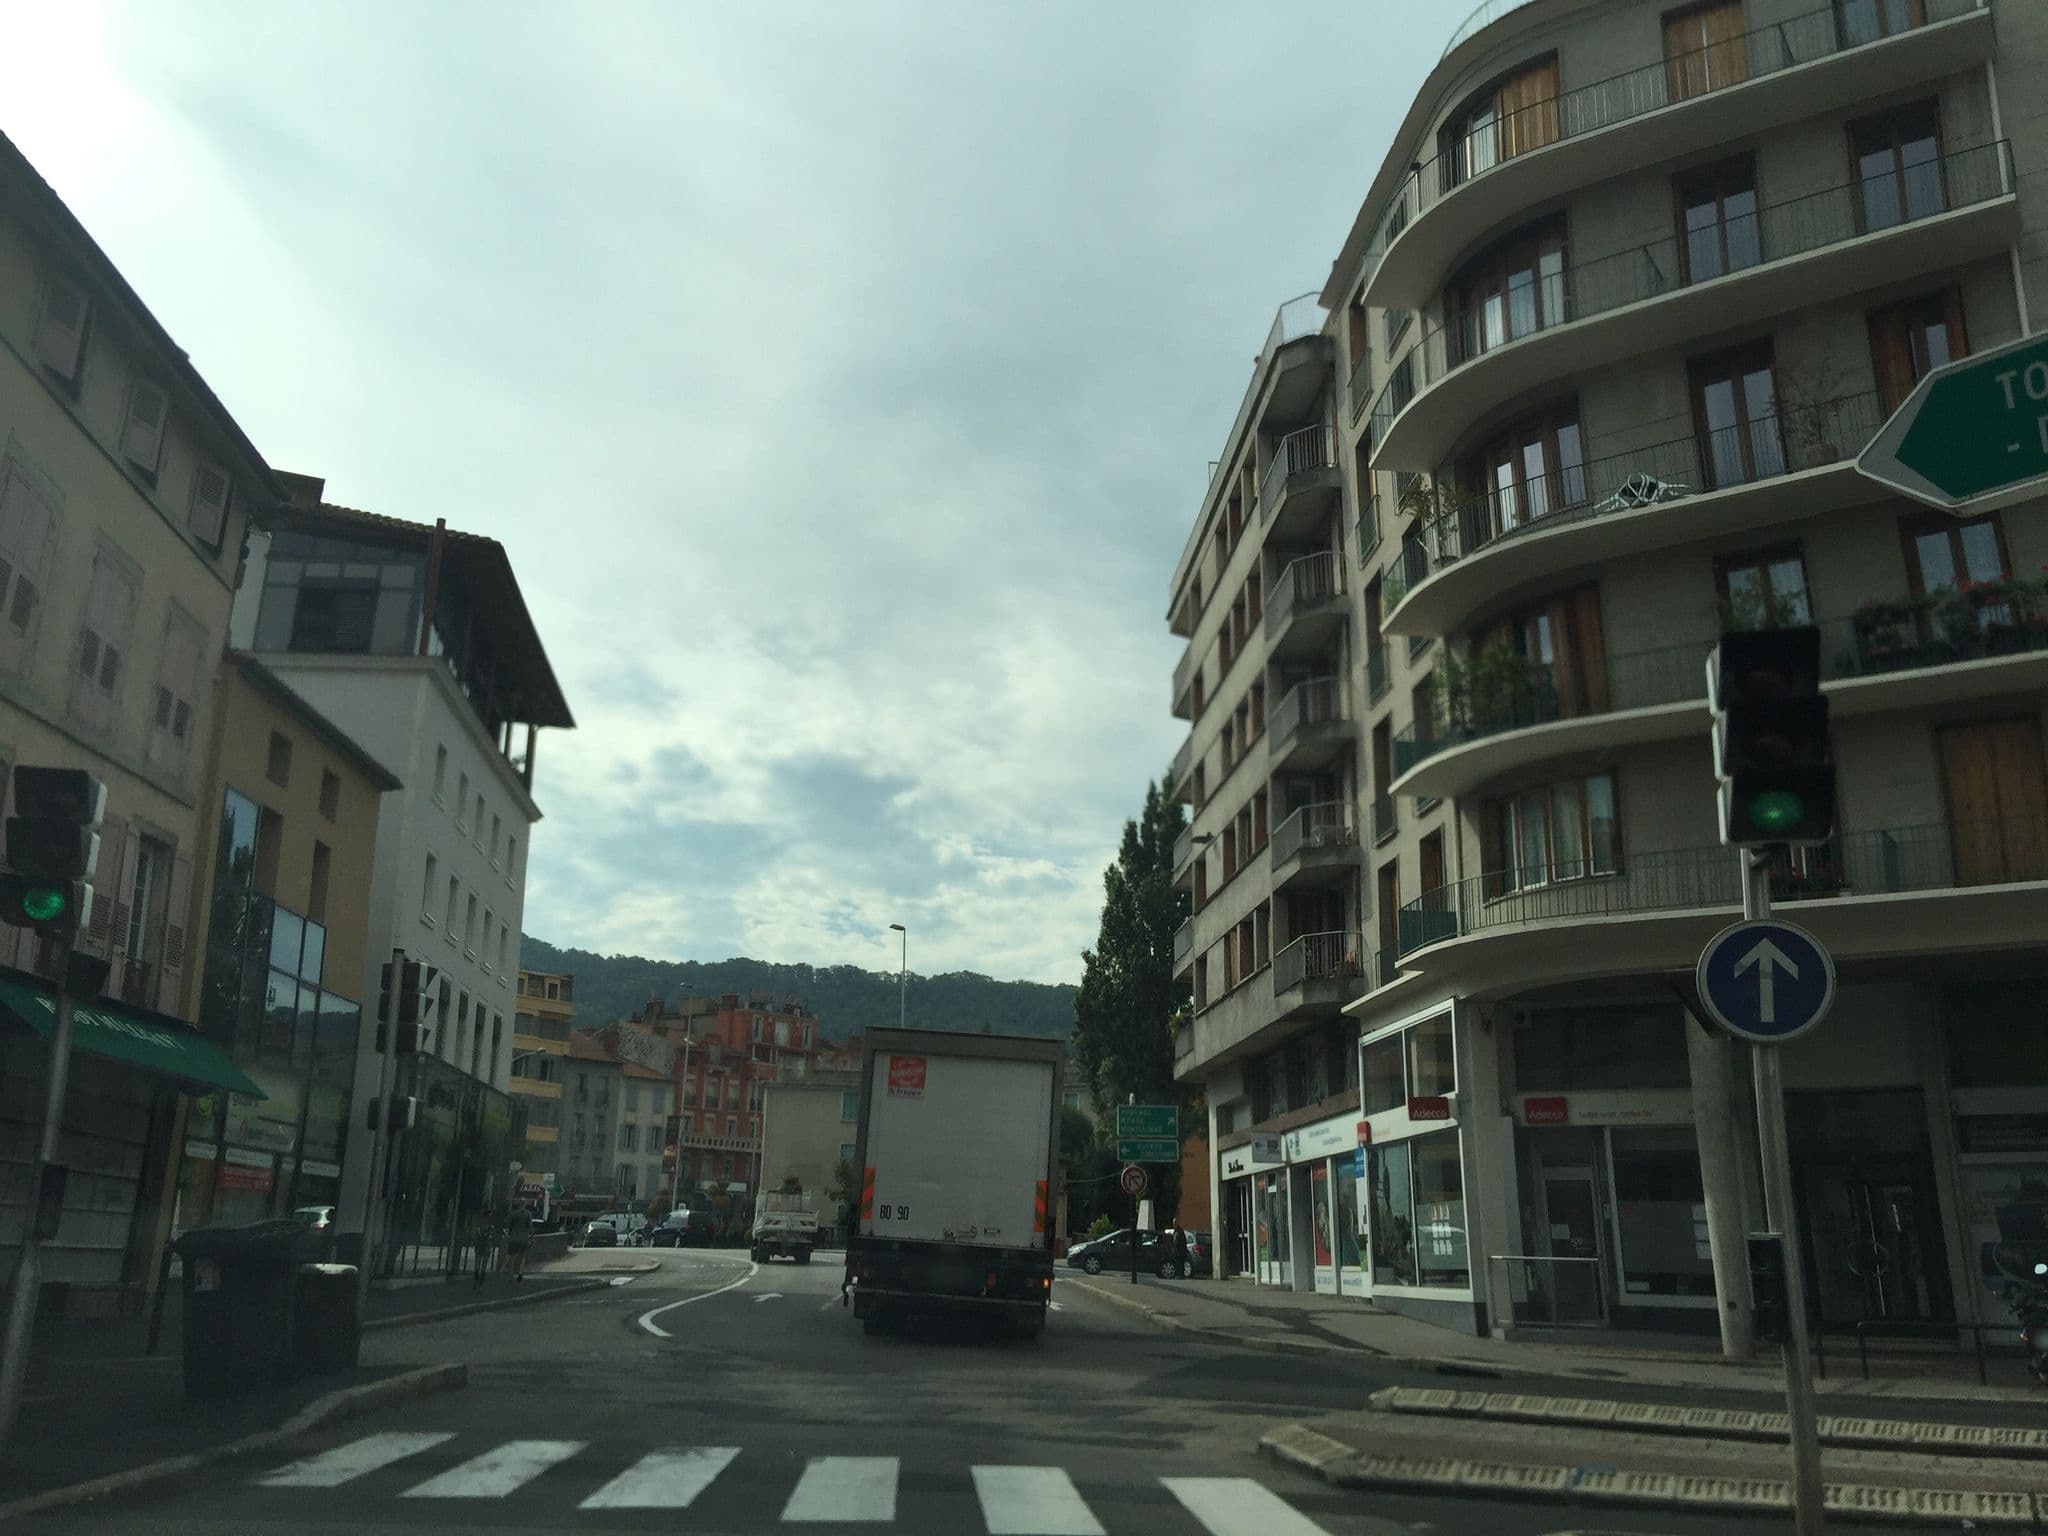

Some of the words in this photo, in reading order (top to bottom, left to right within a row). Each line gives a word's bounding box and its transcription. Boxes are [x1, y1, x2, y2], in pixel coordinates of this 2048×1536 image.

[1413, 1108, 1448, 1120] Adecco
[1528, 1108, 1565, 1121] Adecco
[879, 1204, 892, 1220] 80
[897, 1205, 910, 1221] 90
